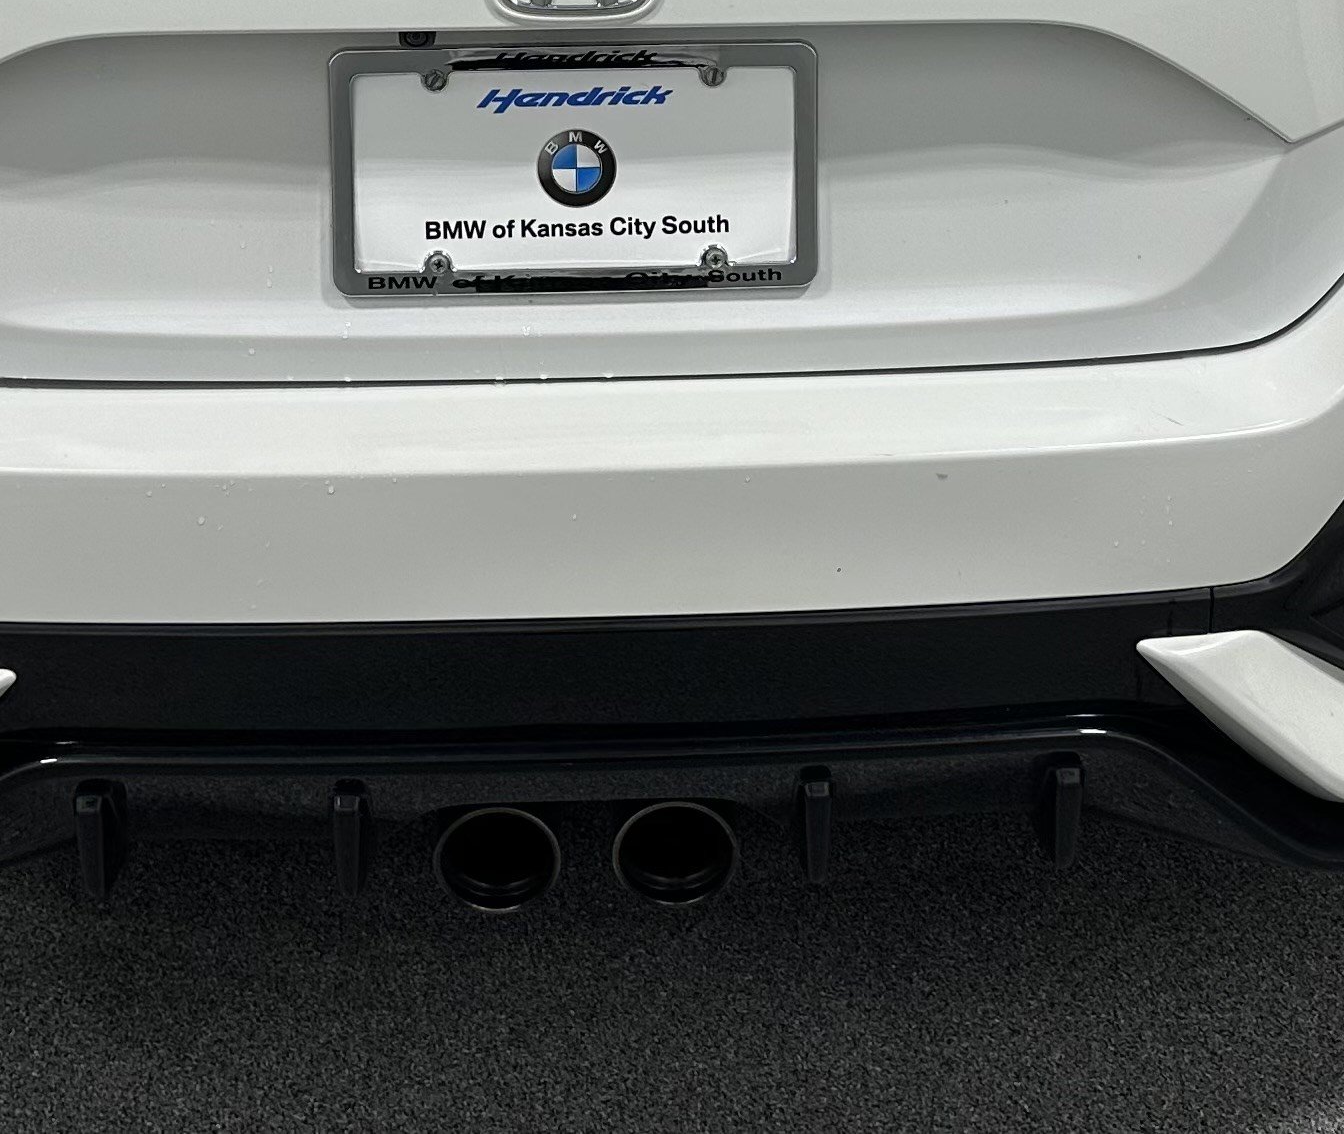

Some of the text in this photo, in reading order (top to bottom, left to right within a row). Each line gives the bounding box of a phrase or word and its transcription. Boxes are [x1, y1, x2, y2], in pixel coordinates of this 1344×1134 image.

[476, 85, 674, 114] Hendrick
[544, 131, 608, 155] BMW
[425, 215, 729, 240] BMW of Kansas City South
[368, 276, 437, 290] BMW
[708, 268, 782, 283] South
